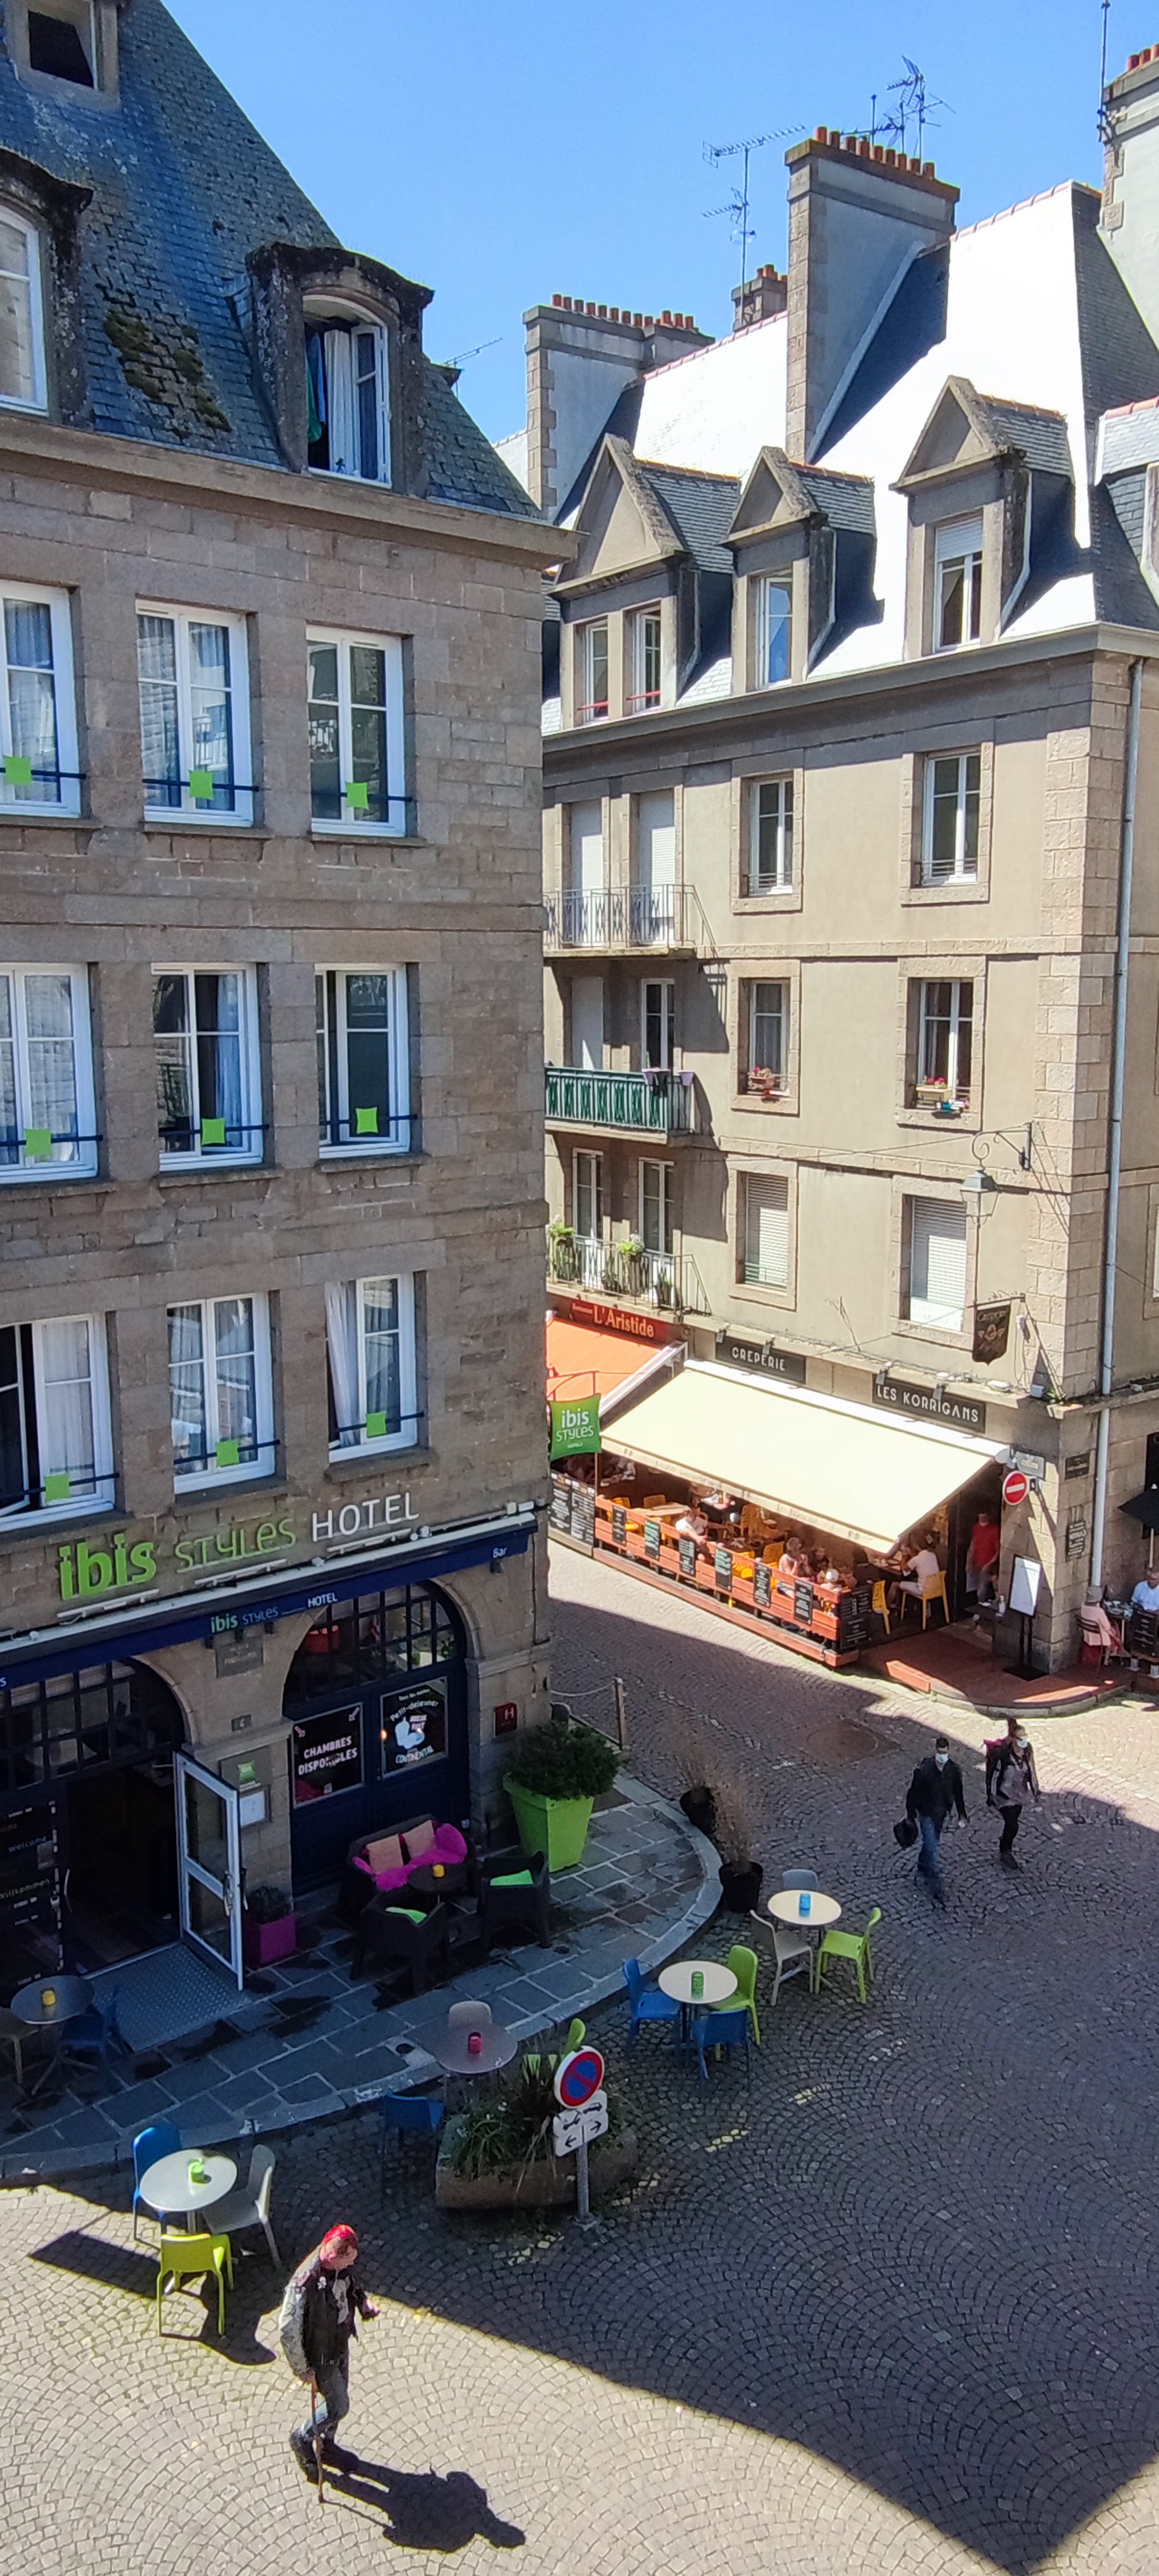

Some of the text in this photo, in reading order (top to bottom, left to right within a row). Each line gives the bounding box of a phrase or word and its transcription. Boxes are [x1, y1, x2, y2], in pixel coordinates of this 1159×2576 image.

[593, 1305, 654, 1338] L'Aristide
[732, 1346, 786, 1372] CREPERIE
[877, 1385, 979, 1422] LES KORRIGANS
[561, 1408, 589, 1429] ibis
[59, 1533, 157, 1600] ibis
[311, 1492, 420, 1542] HOTEL
[493, 1547, 508, 1559] Bar
[211, 1612, 238, 1634] ibis
[307, 1592, 338, 1608] HOTEL
[505, 1707, 514, 1720] H
[303, 1735, 352, 1759] CHAMBRES
